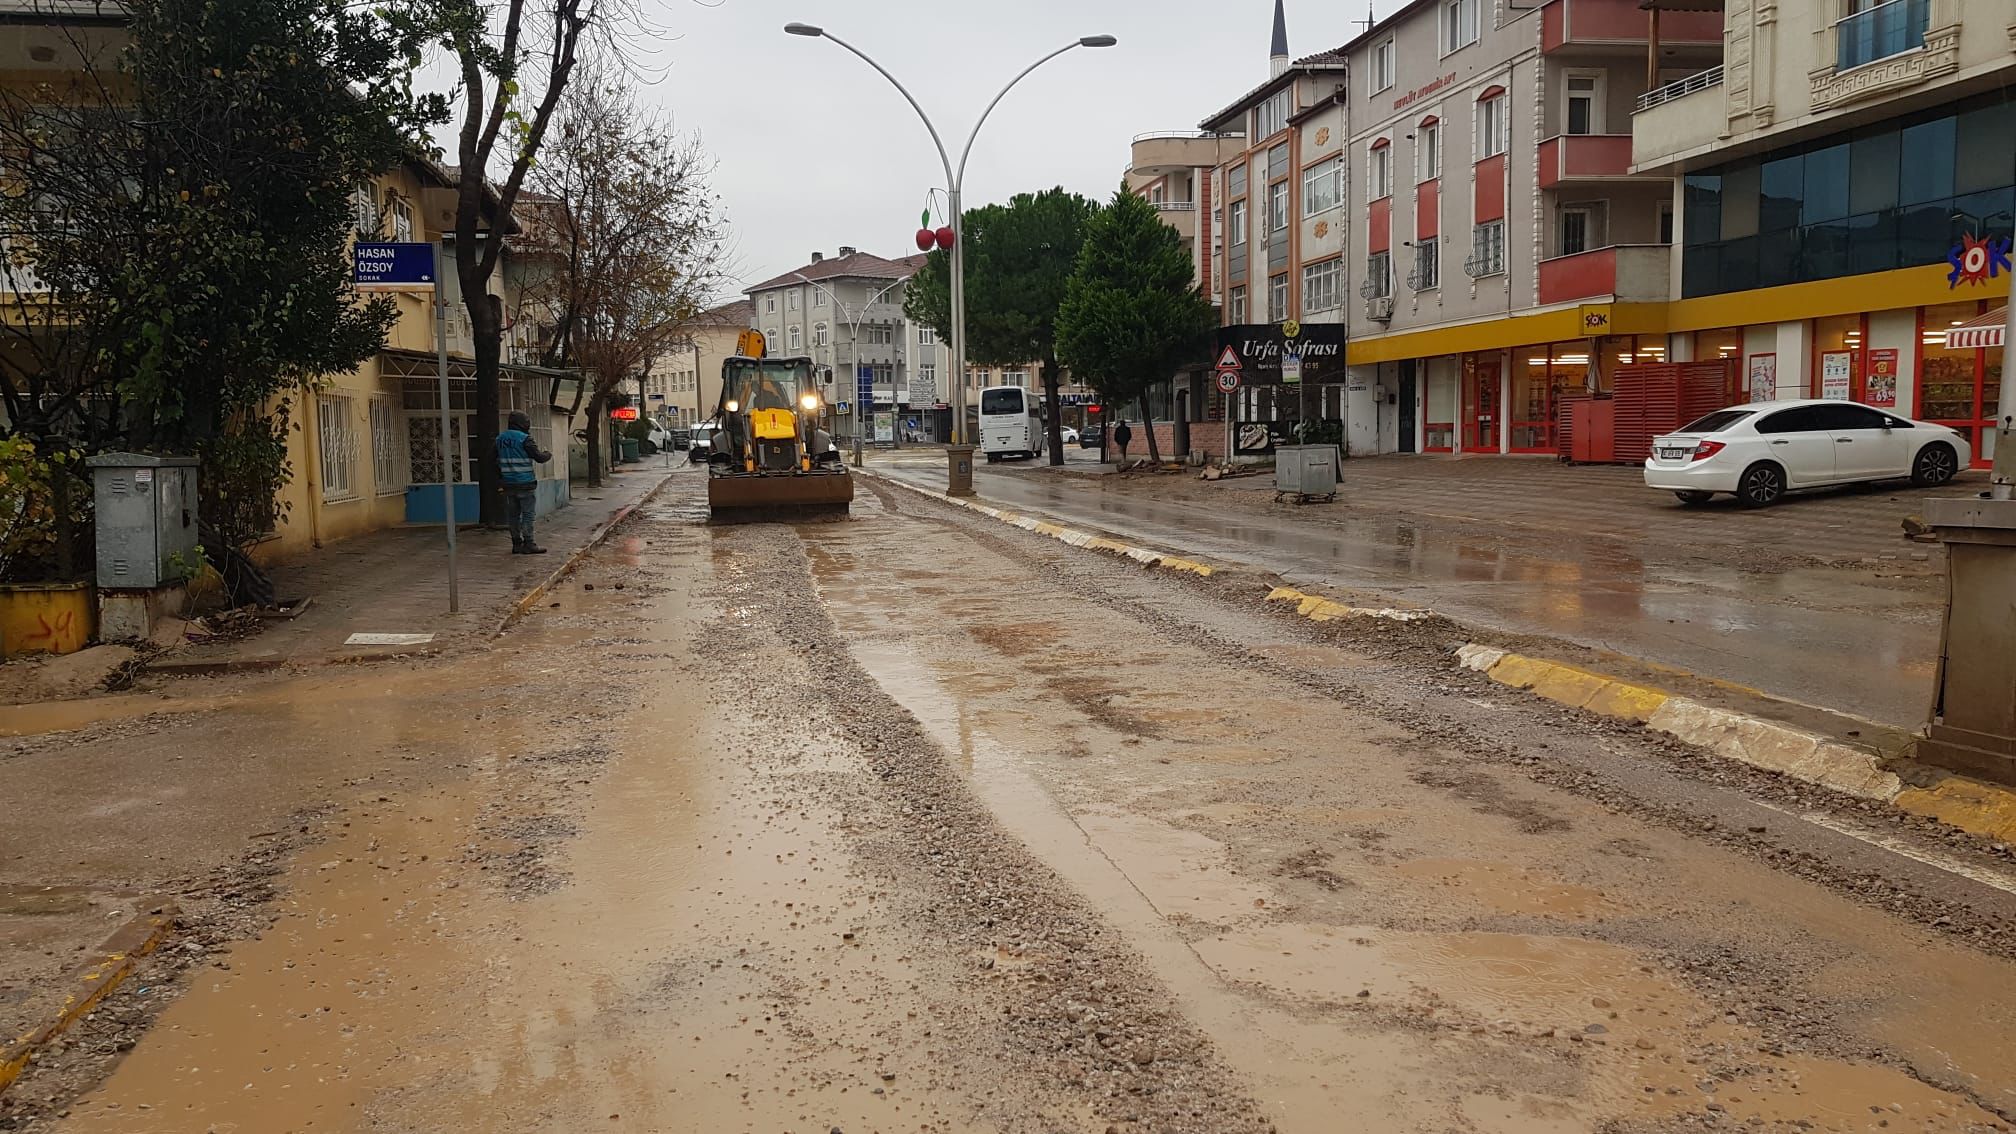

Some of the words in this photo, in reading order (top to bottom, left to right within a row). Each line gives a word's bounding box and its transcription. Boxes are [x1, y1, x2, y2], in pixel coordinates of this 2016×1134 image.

[357, 248, 395, 259] HASAN
[358, 260, 394, 273] ÖZSOY
[1946, 236, 2013, 291] ŞOK
[1242, 340, 1278, 361] Urfa
[1282, 339, 1339, 360] Sofrası
[1221, 375, 1235, 386] 30
